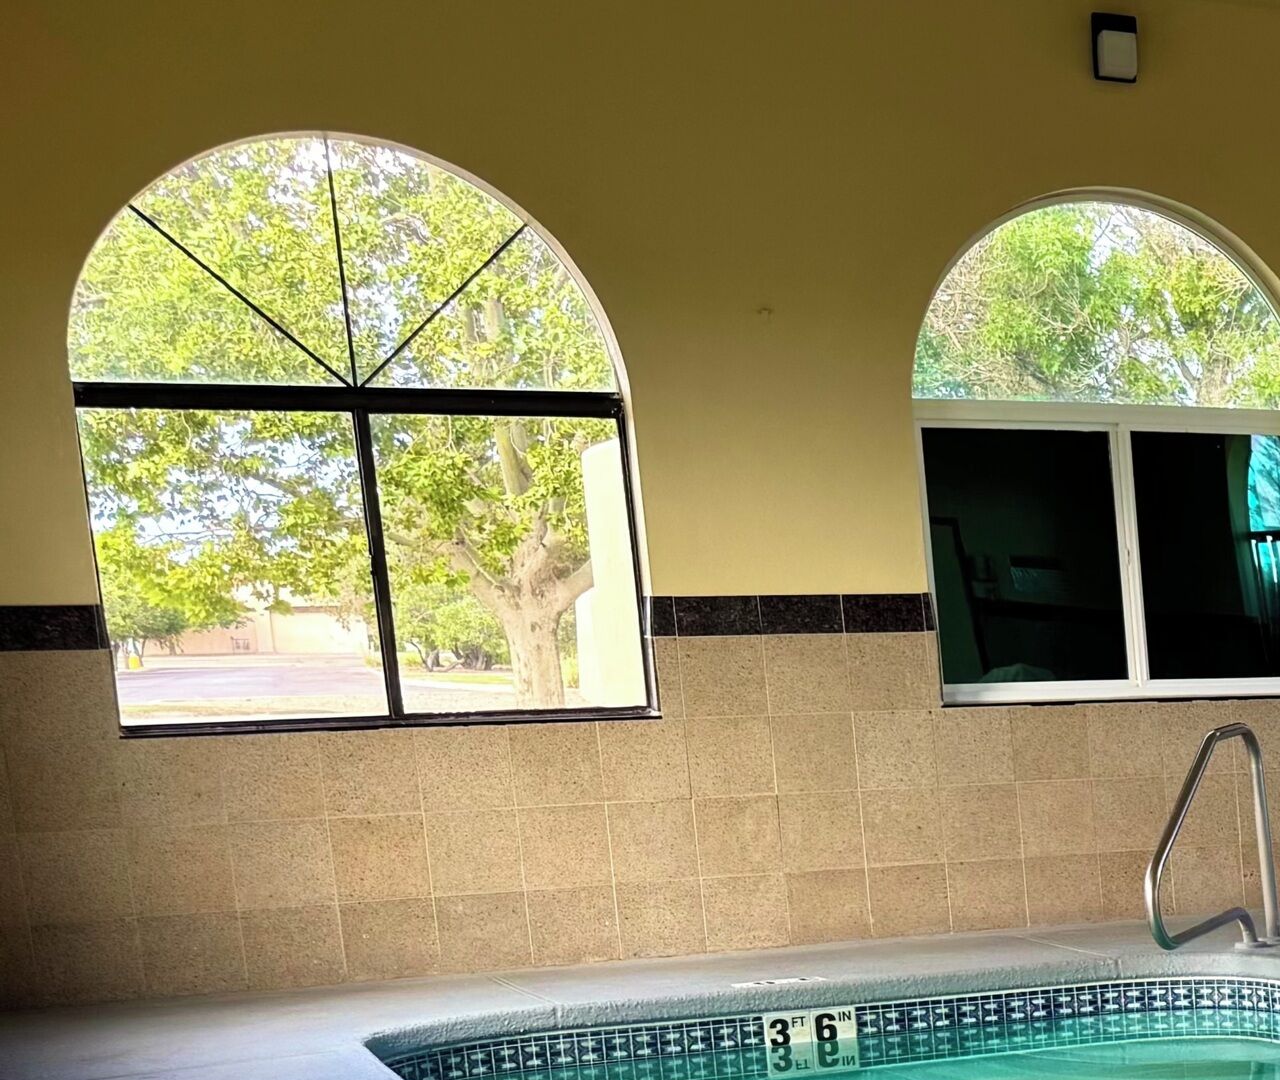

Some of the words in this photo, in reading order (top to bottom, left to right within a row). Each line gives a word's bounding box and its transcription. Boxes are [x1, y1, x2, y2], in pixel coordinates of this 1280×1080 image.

[769, 1018, 791, 1047] 3
[791, 1016, 806, 1028] FT
[815, 1013, 838, 1041] 6
[838, 1010, 852, 1022] IN
